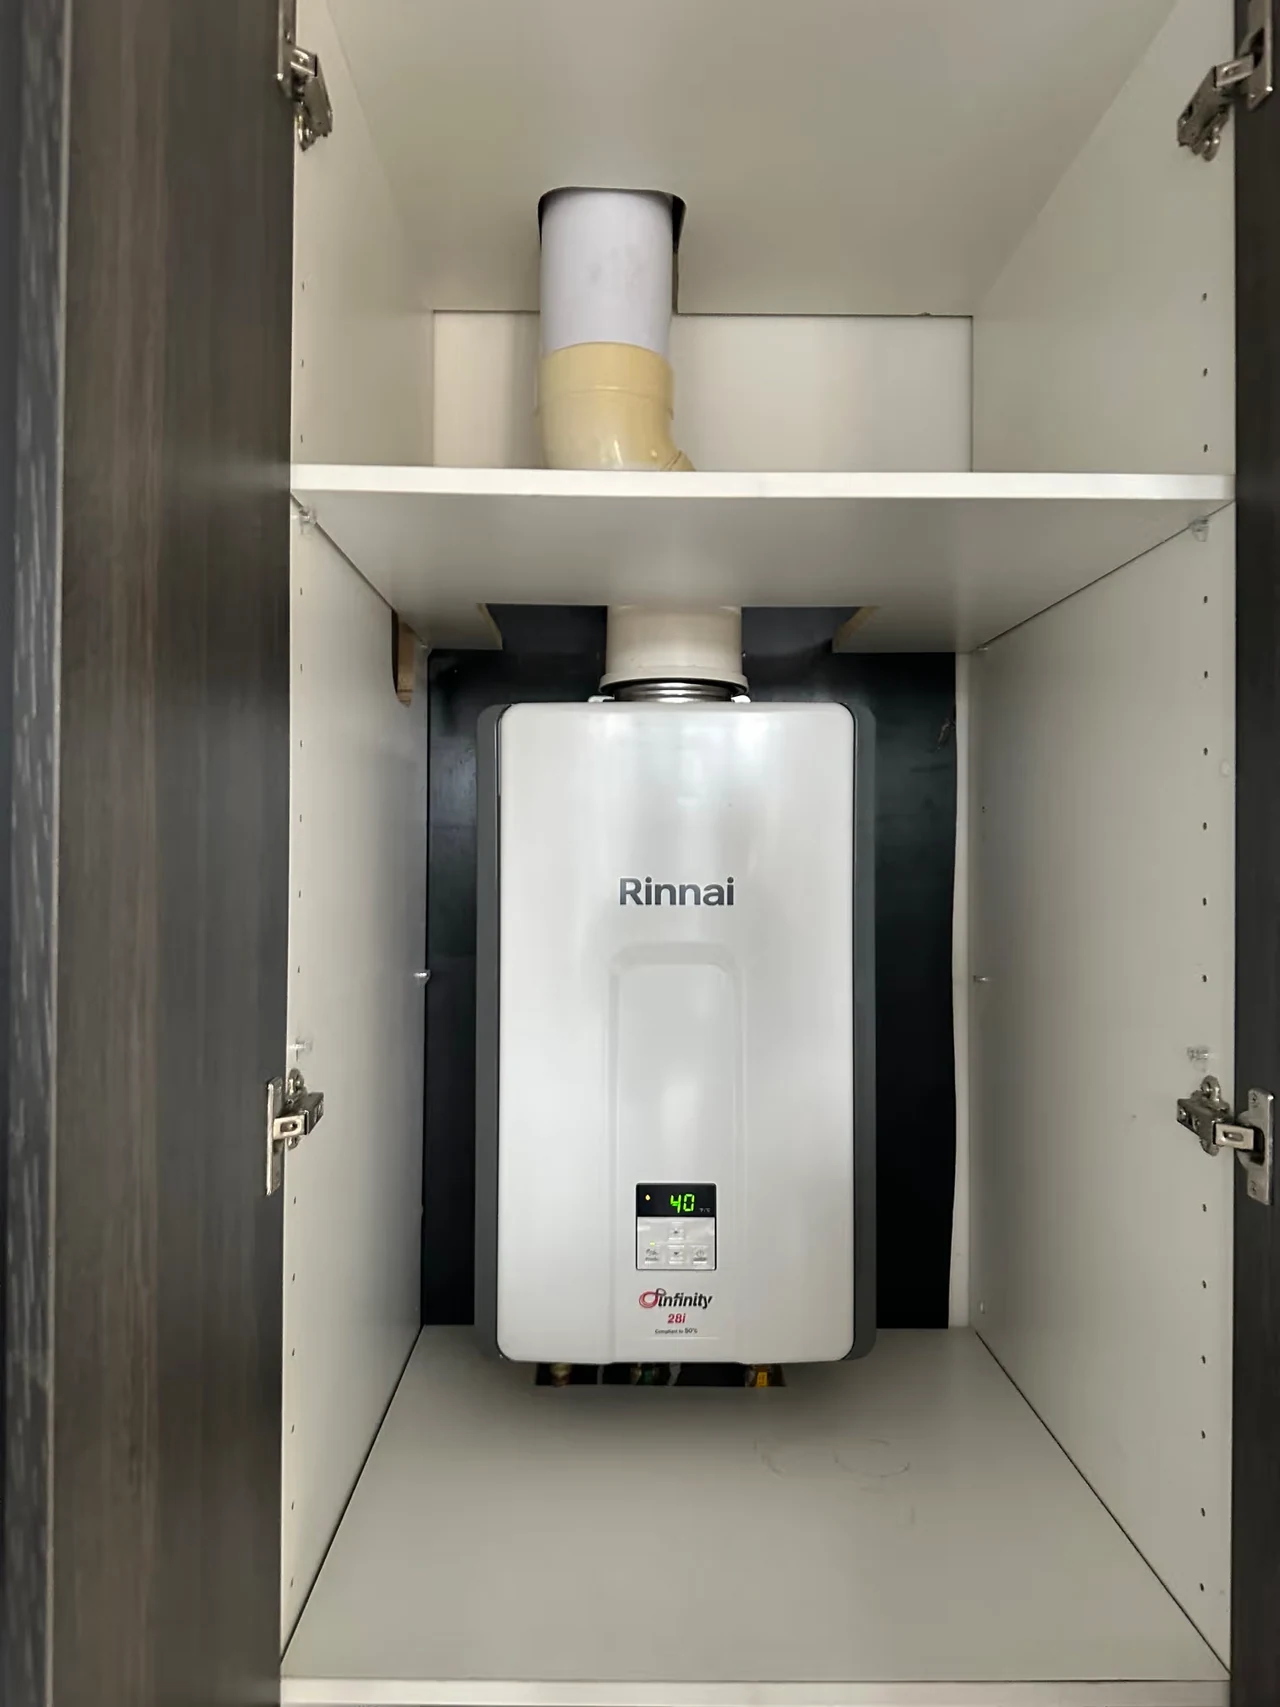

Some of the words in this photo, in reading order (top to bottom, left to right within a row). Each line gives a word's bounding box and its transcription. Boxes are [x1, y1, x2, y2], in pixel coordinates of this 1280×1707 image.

[620, 876, 735, 906] Rinnai
[670, 1193, 695, 1213] 40
[667, 1313, 686, 1324] 28i
